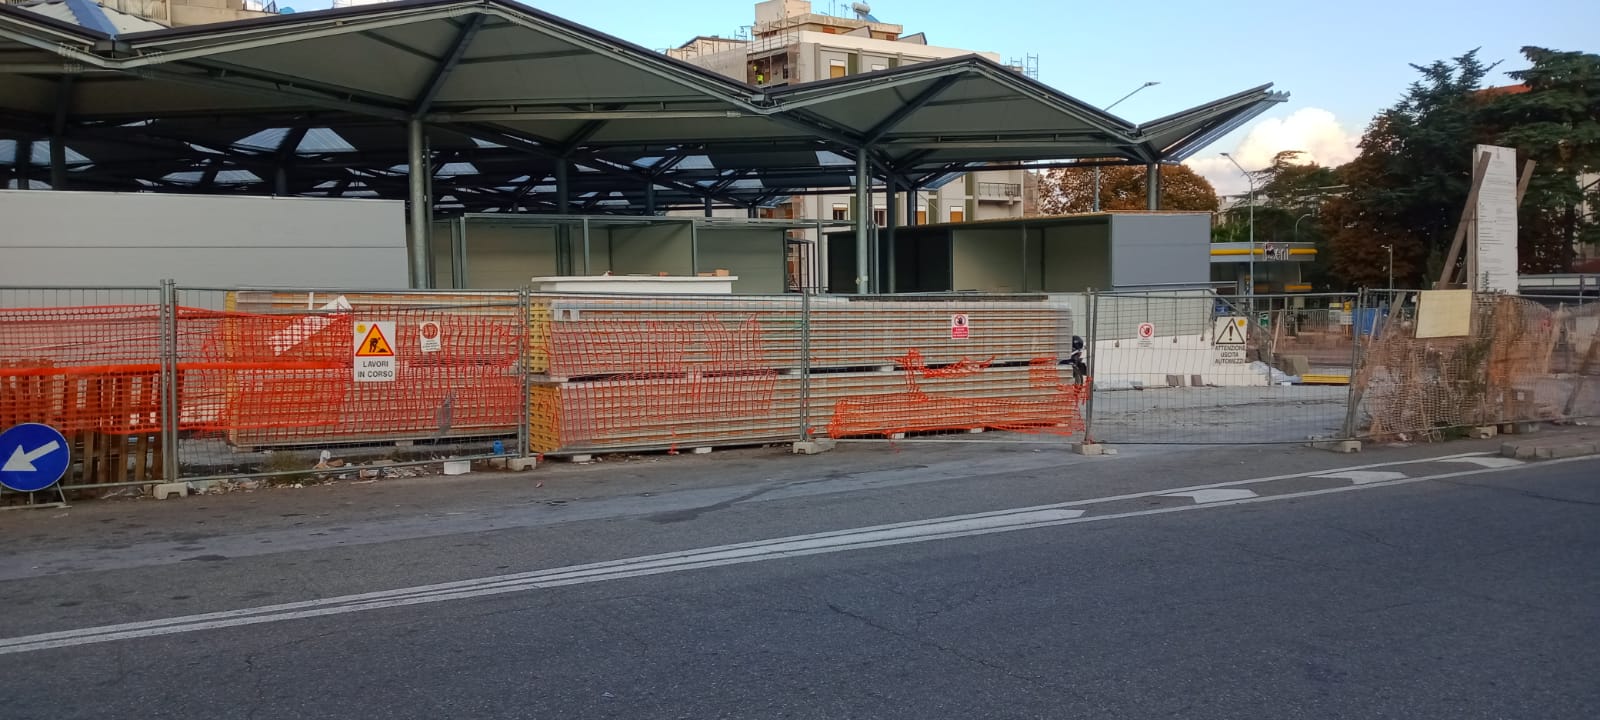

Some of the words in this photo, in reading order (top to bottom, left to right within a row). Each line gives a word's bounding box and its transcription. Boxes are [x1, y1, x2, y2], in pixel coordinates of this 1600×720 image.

[1275, 244, 1289, 261] eni
[362, 360, 389, 368] LAVORI
[367, 370, 393, 378] CORSO
